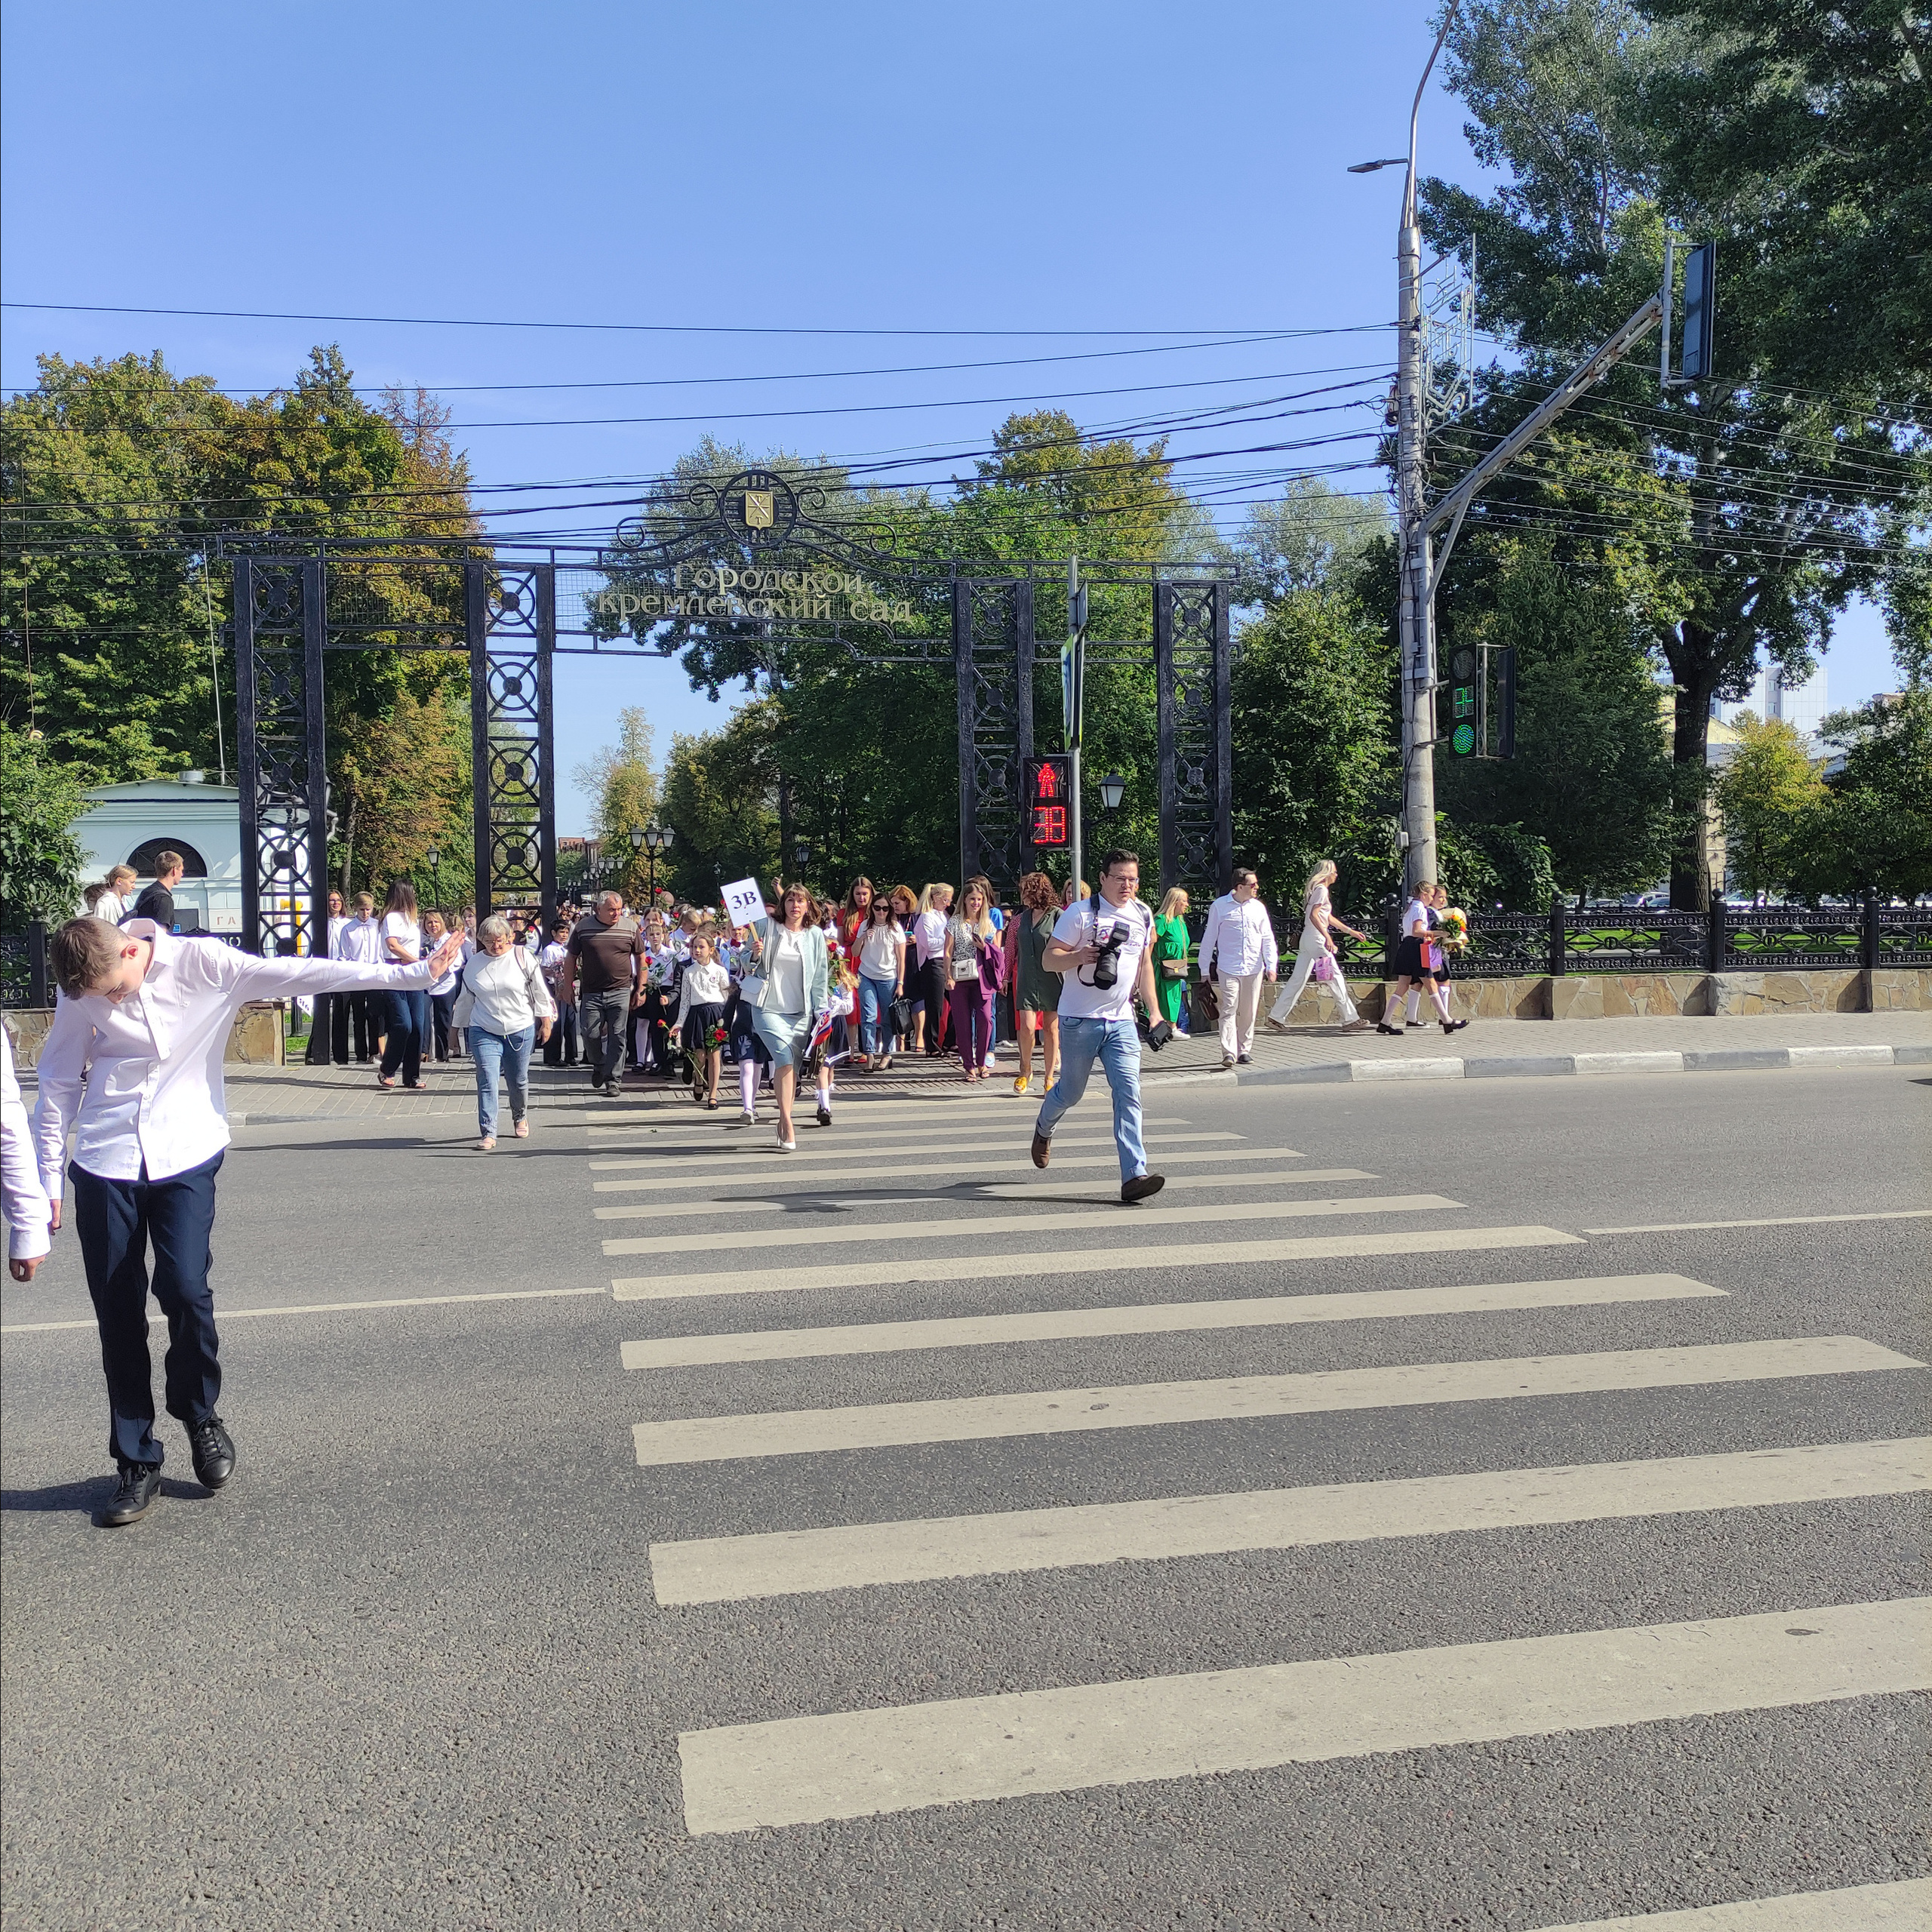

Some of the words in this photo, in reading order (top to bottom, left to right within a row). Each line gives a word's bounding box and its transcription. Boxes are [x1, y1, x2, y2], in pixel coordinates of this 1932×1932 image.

[674, 564, 864, 595] Городской
[597, 592, 830, 621] кремлевский
[850, 599, 914, 625] сад
[1034, 806, 1066, 844] 38
[731, 891, 757, 909] 3В
[217, 915, 242, 926] ГА
